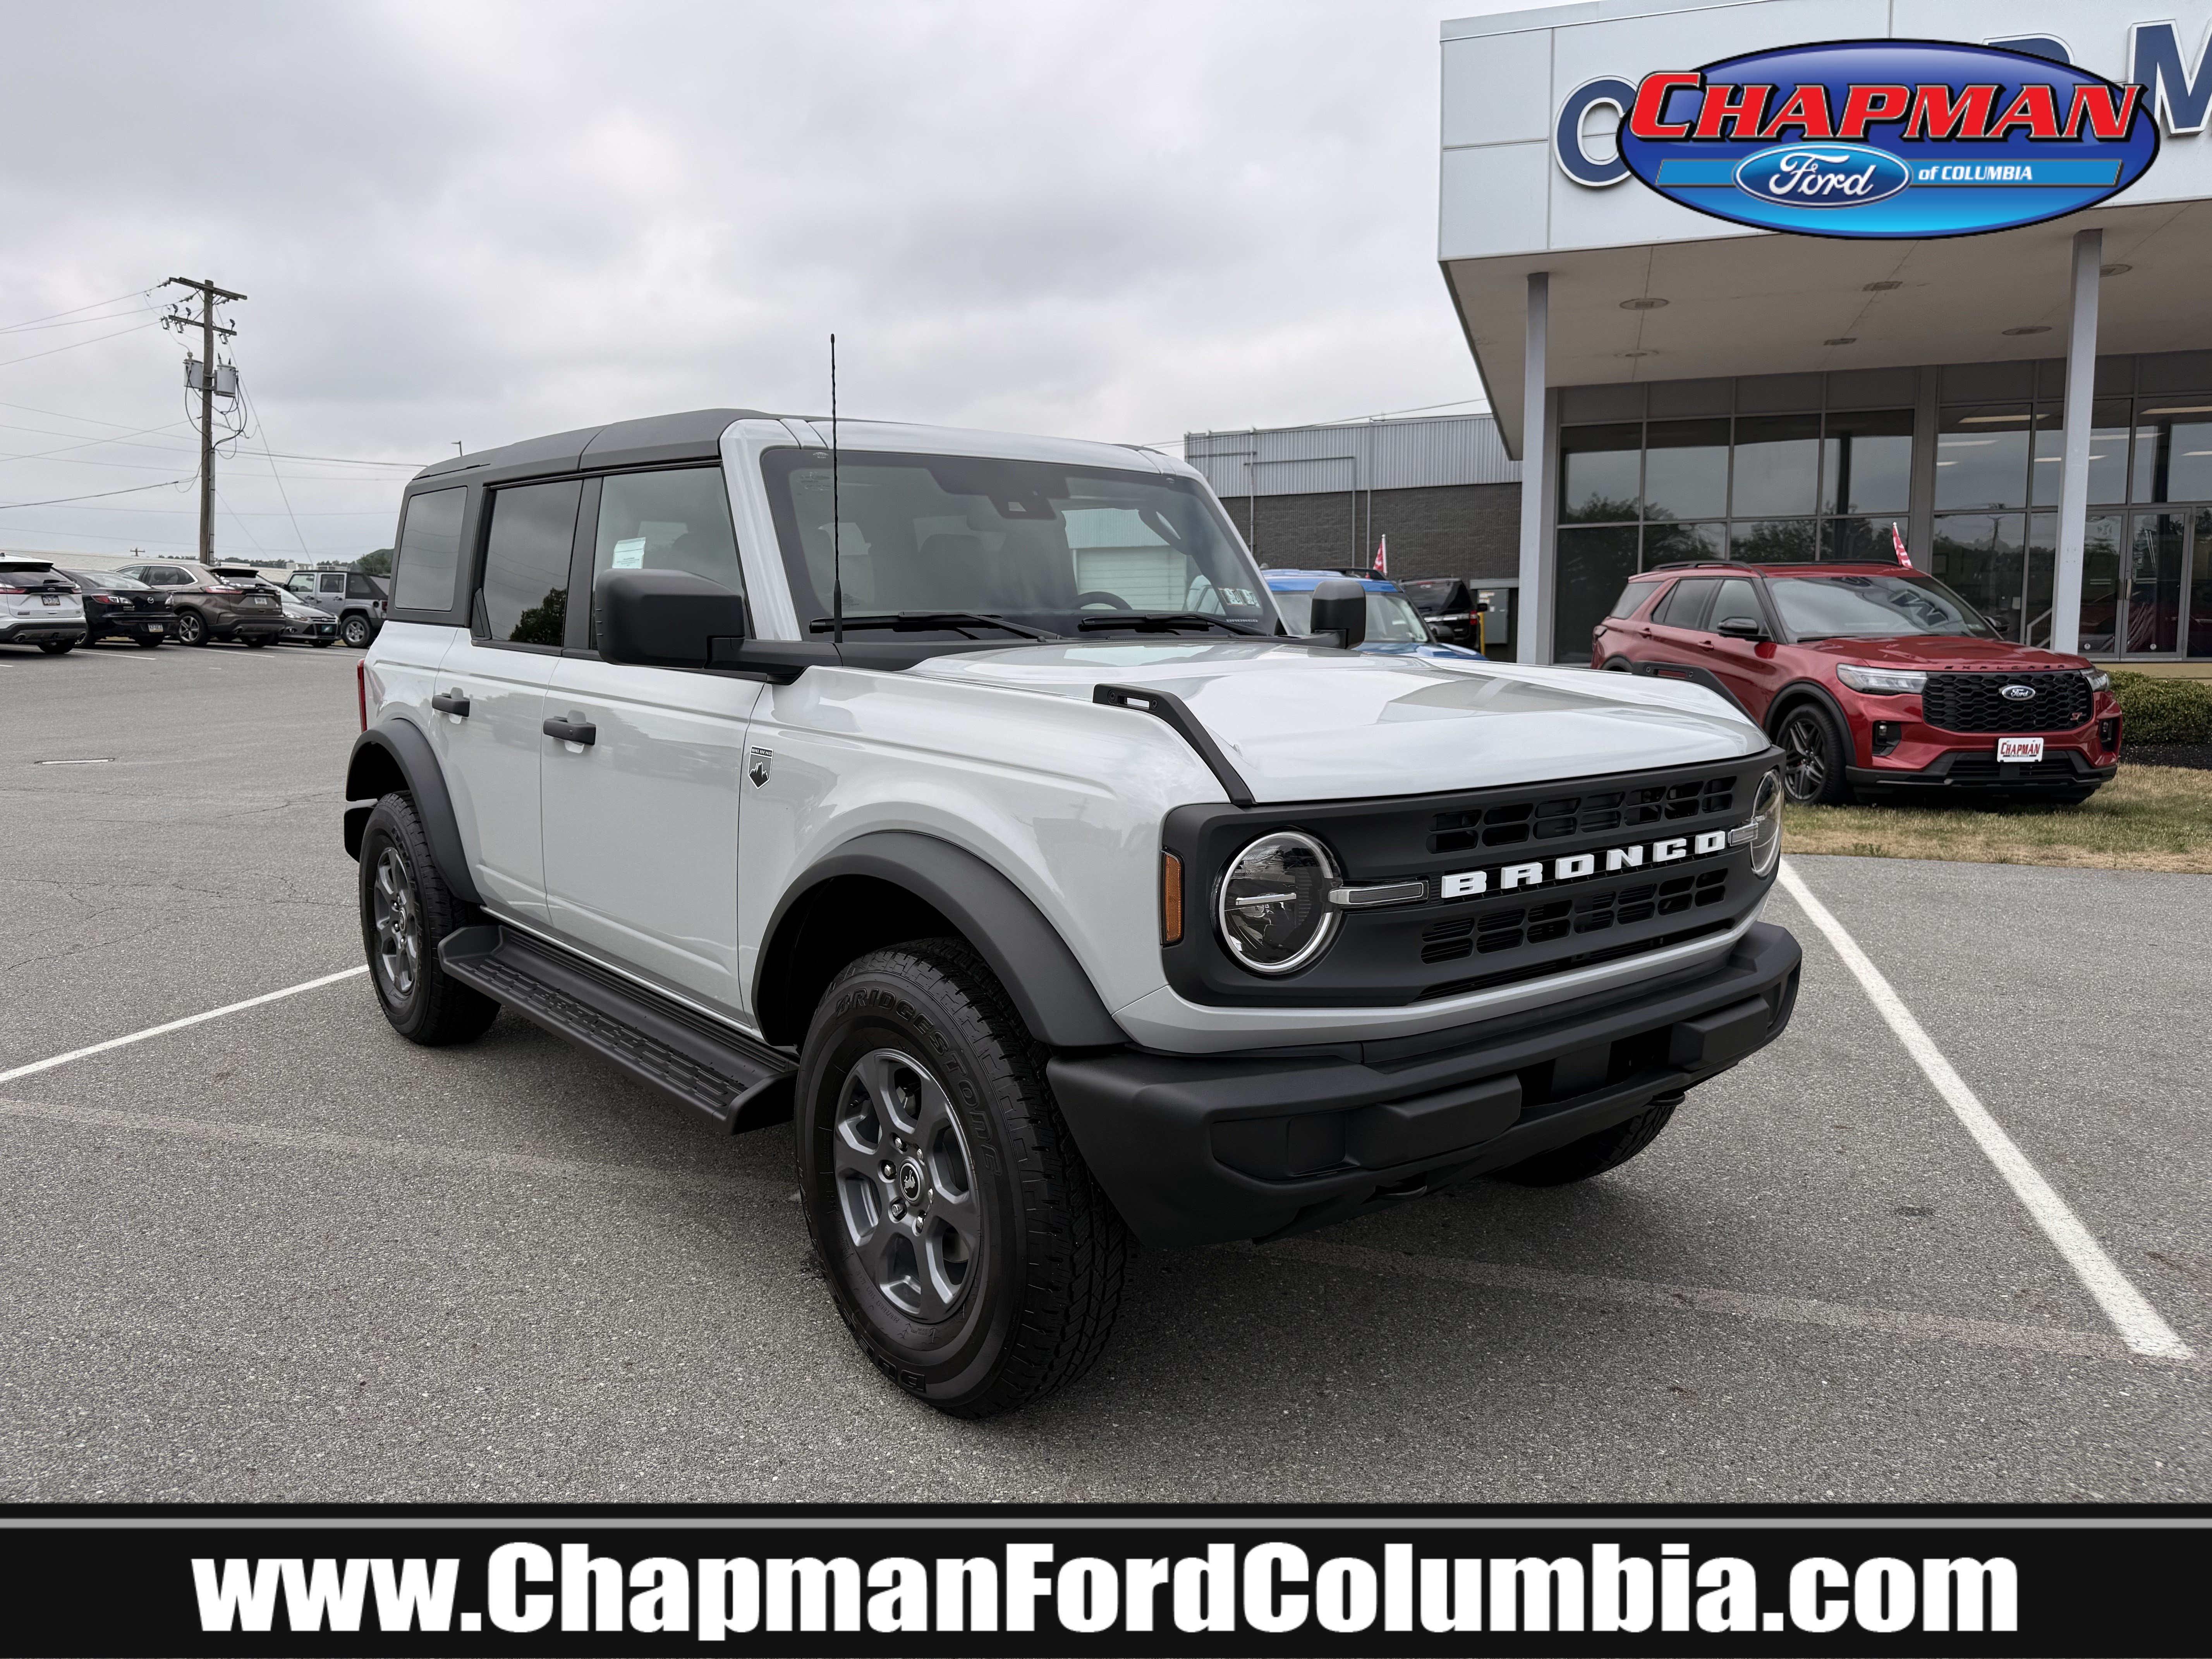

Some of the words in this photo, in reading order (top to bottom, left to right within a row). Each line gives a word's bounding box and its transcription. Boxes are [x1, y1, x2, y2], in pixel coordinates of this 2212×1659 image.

[2010, 688, 2029, 697] Ford
[2000, 742, 2040, 755] CHAPMAN
[1441, 830, 1726, 898] BRONCO
[835, 988, 1003, 1177] BRIDGESTONE
